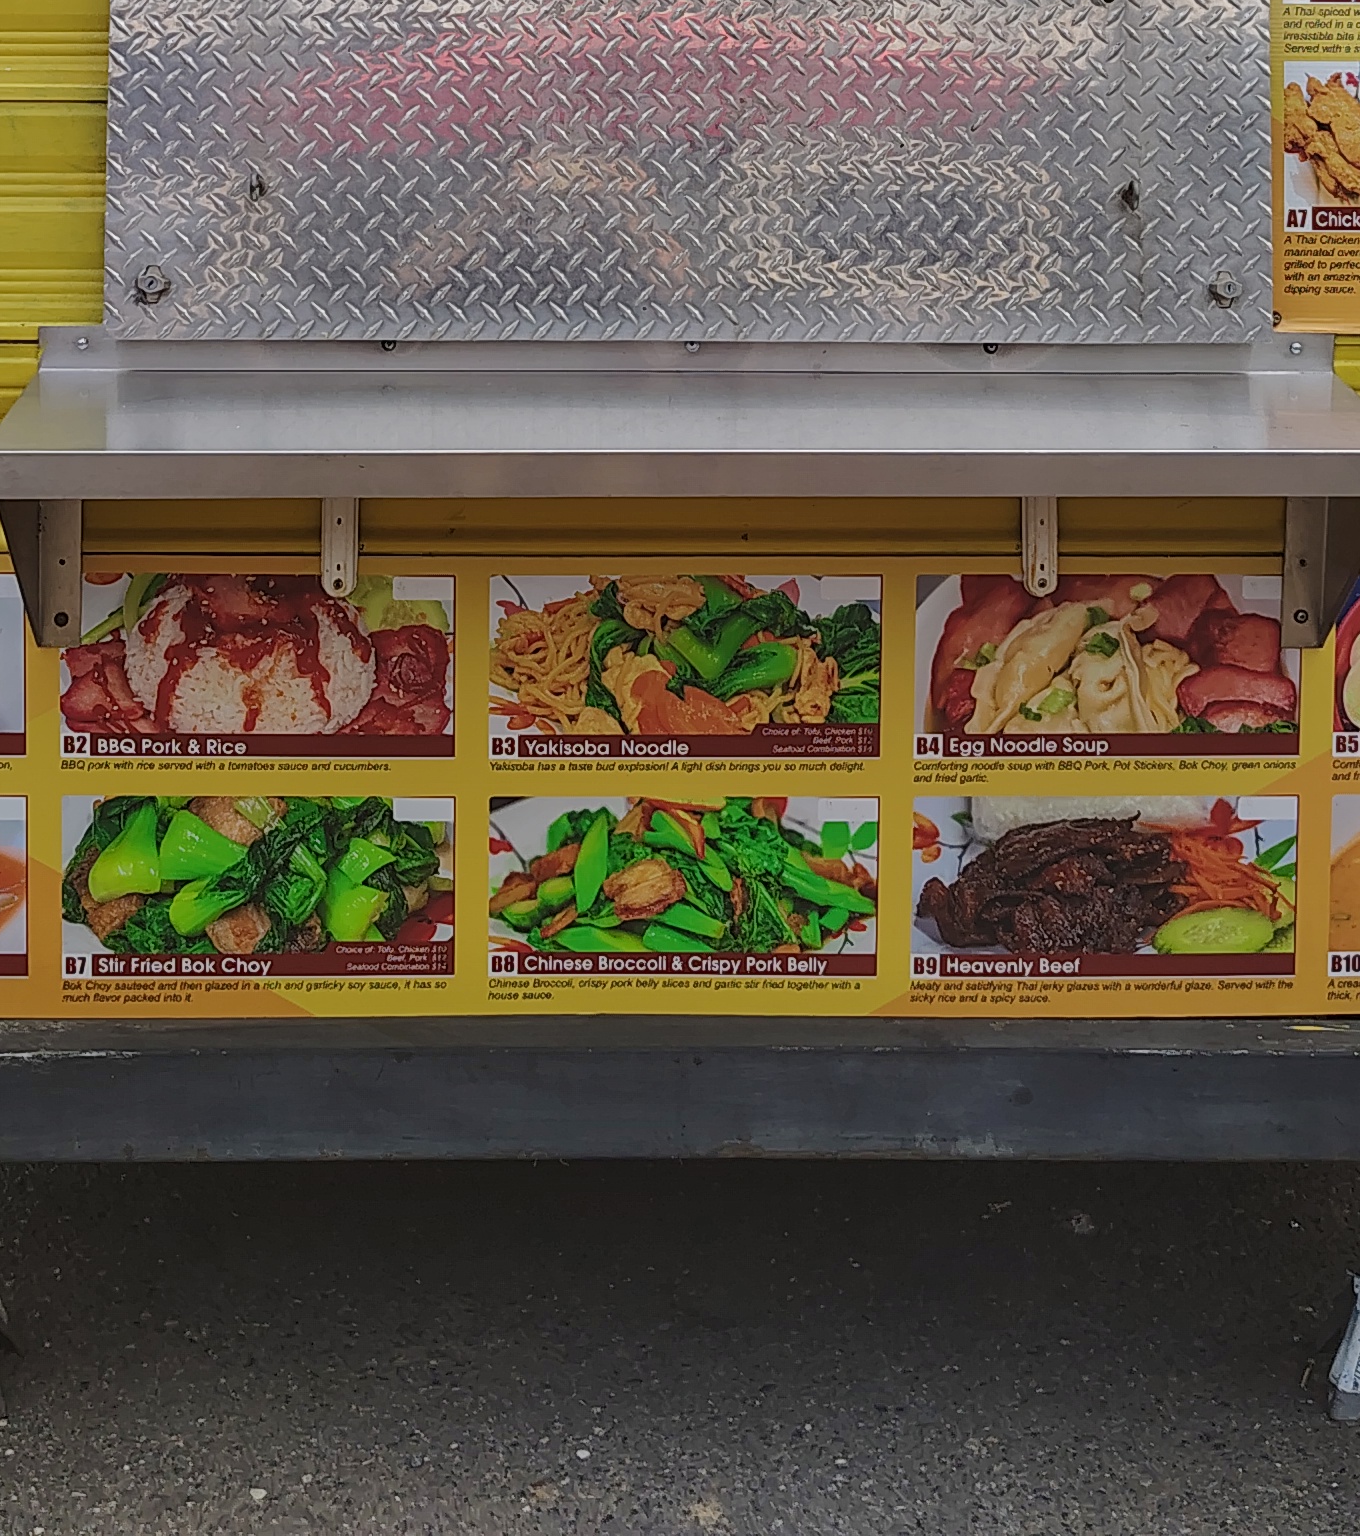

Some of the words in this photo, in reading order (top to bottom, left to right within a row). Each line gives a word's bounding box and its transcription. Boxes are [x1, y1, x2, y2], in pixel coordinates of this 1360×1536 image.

[1287, 209, 1307, 227] A7
[1284, 236, 1291, 244] A
[1296, 235, 1317, 244] Thai
[1320, 235, 1359, 244] Chicken
[1284, 248, 1335, 256] marinated
[1284, 260, 1314, 270] grilled
[1318, 260, 1327, 269] to
[1284, 272, 1304, 281] with
[1284, 285, 1321, 295] dipping
[64, 736, 87, 754] B2
[97, 739, 136, 754] BBQ
[142, 739, 182, 755] Pork
[188, 739, 200, 755] &
[206, 739, 247, 755] Rice
[492, 738, 515, 755] B3
[524, 740, 610, 756] Yakisoba
[622, 741, 689, 756] Noodle
[917, 738, 939, 755] B4
[950, 738, 984, 756] Egg
[991, 738, 1057, 754] Noodle
[1063, 738, 1109, 756] Soup
[1336, 736, 1360, 753] B5
[61, 760, 85, 770] BBQ
[88, 760, 110, 772] pork
[114, 761, 133, 771] with
[136, 761, 155, 771] rice
[158, 761, 192, 771] served
[196, 762, 216, 772] with
[229, 762, 275, 772] tomatoes
[279, 763, 308, 772] sauce
[311, 762, 331, 772] and
[65, 957, 86, 974] B7
[99, 958, 125, 973] Stir
[131, 958, 176, 973] Fried
[183, 958, 217, 973] Bok
[222, 957, 272, 976] Choy
[492, 956, 514, 973] B8
[524, 956, 593, 971] Chinese
[599, 956, 666, 971] Broccoli
[672, 957, 683, 971] &
[689, 956, 740, 974] Crispy
[746, 958, 782, 973] Pork
[787, 958, 827, 974] Belly
[914, 957, 937, 974] B9
[947, 958, 1033, 976] Heavenly
[1040, 958, 1081, 974] Beef
[489, 978, 530, 989] Chinese
[579, 979, 607, 990] crispy
[610, 980, 633, 990] pork
[636, 980, 659, 991] belly
[662, 980, 690, 990] slices
[693, 980, 711, 990] and
[745, 980, 760, 990] stir
[763, 980, 784, 990] fried
[787, 980, 828, 992] together
[832, 981, 852, 990] with
